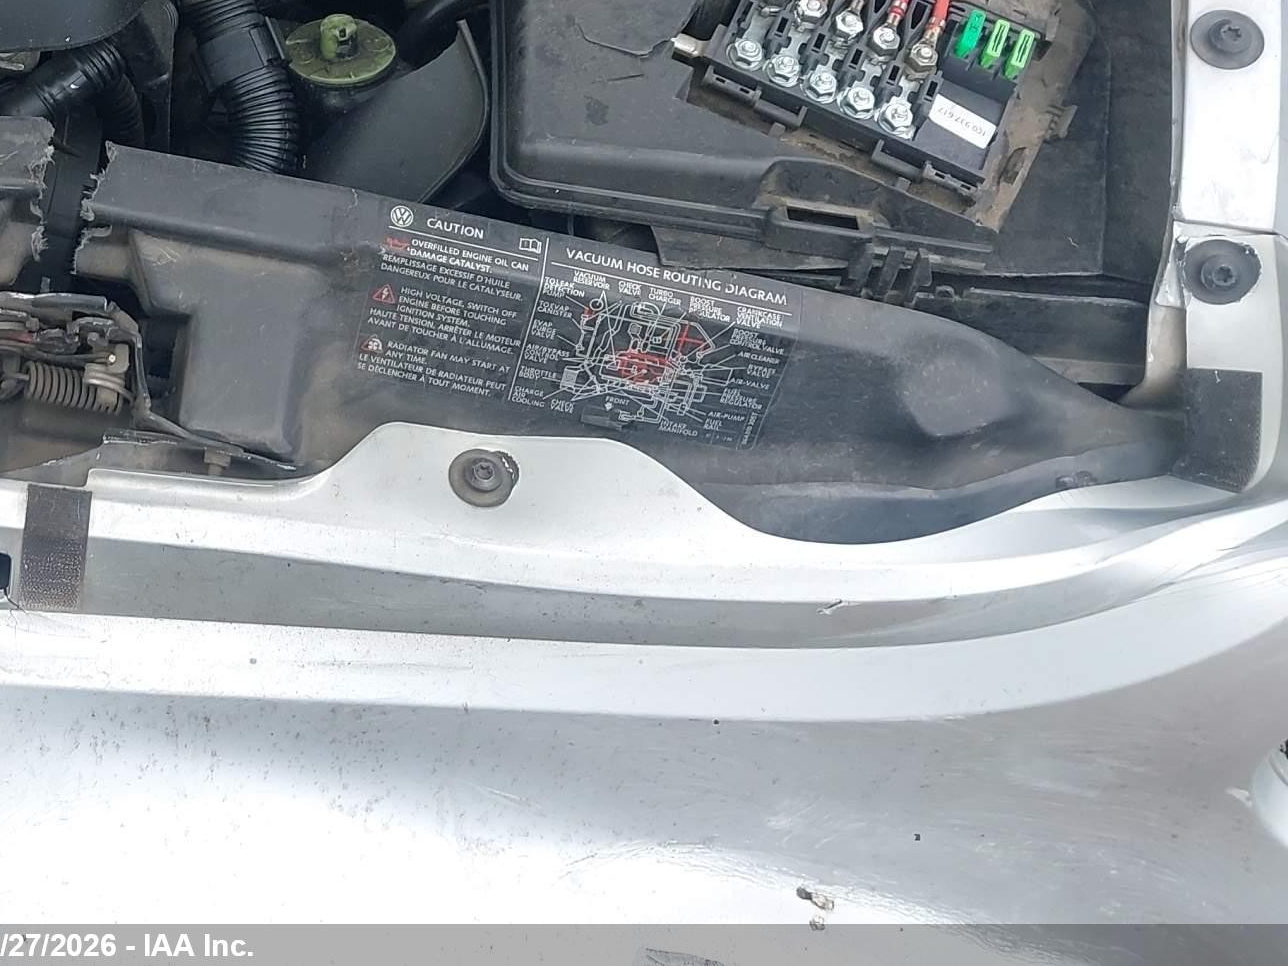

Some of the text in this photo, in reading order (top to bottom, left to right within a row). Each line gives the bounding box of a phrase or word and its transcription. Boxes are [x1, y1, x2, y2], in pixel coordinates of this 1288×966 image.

[426, 216, 484, 239] CAUTION
[383, 253, 510, 288] REMPLISSAGE EXCESSIF D'HUILE
[410, 247, 493, 273] DAMAGE CATALYST.
[411, 238, 529, 271] OVERFILLED ENGINE OIL CAN
[381, 262, 523, 301] DANGEREUX POUR LE CATALYSEUR.
[565, 248, 788, 305] VACUUM HOSE ROUTING DIAGRAM
[396, 304, 470, 327] IGNITION SYSTEM.
[398, 295, 507, 326] ENGINE BEFORE TOUCHING
[400, 287, 517, 319] HIGH SWITCH OFF
[367, 316, 396, 329] AVANT
[398, 323, 409, 332] DE
[412, 326, 448, 340] TOUCHER
[369, 307, 520, 347] HAUTE ARRÊTER LE MOTEUR
[359, 352, 506, 391] LE VENTILATEUR DE RADIATEUR PEUT
[385, 349, 428, 365] ANY TIME.
[388, 340, 510, 373] RADIATOR FAN MAY START AT
[357, 361, 366, 370] SE
[368, 363, 417, 381] DÉCLENCHER
[428, 377, 450, 388] TOUT
[452, 382, 490, 397] MOMENT.
